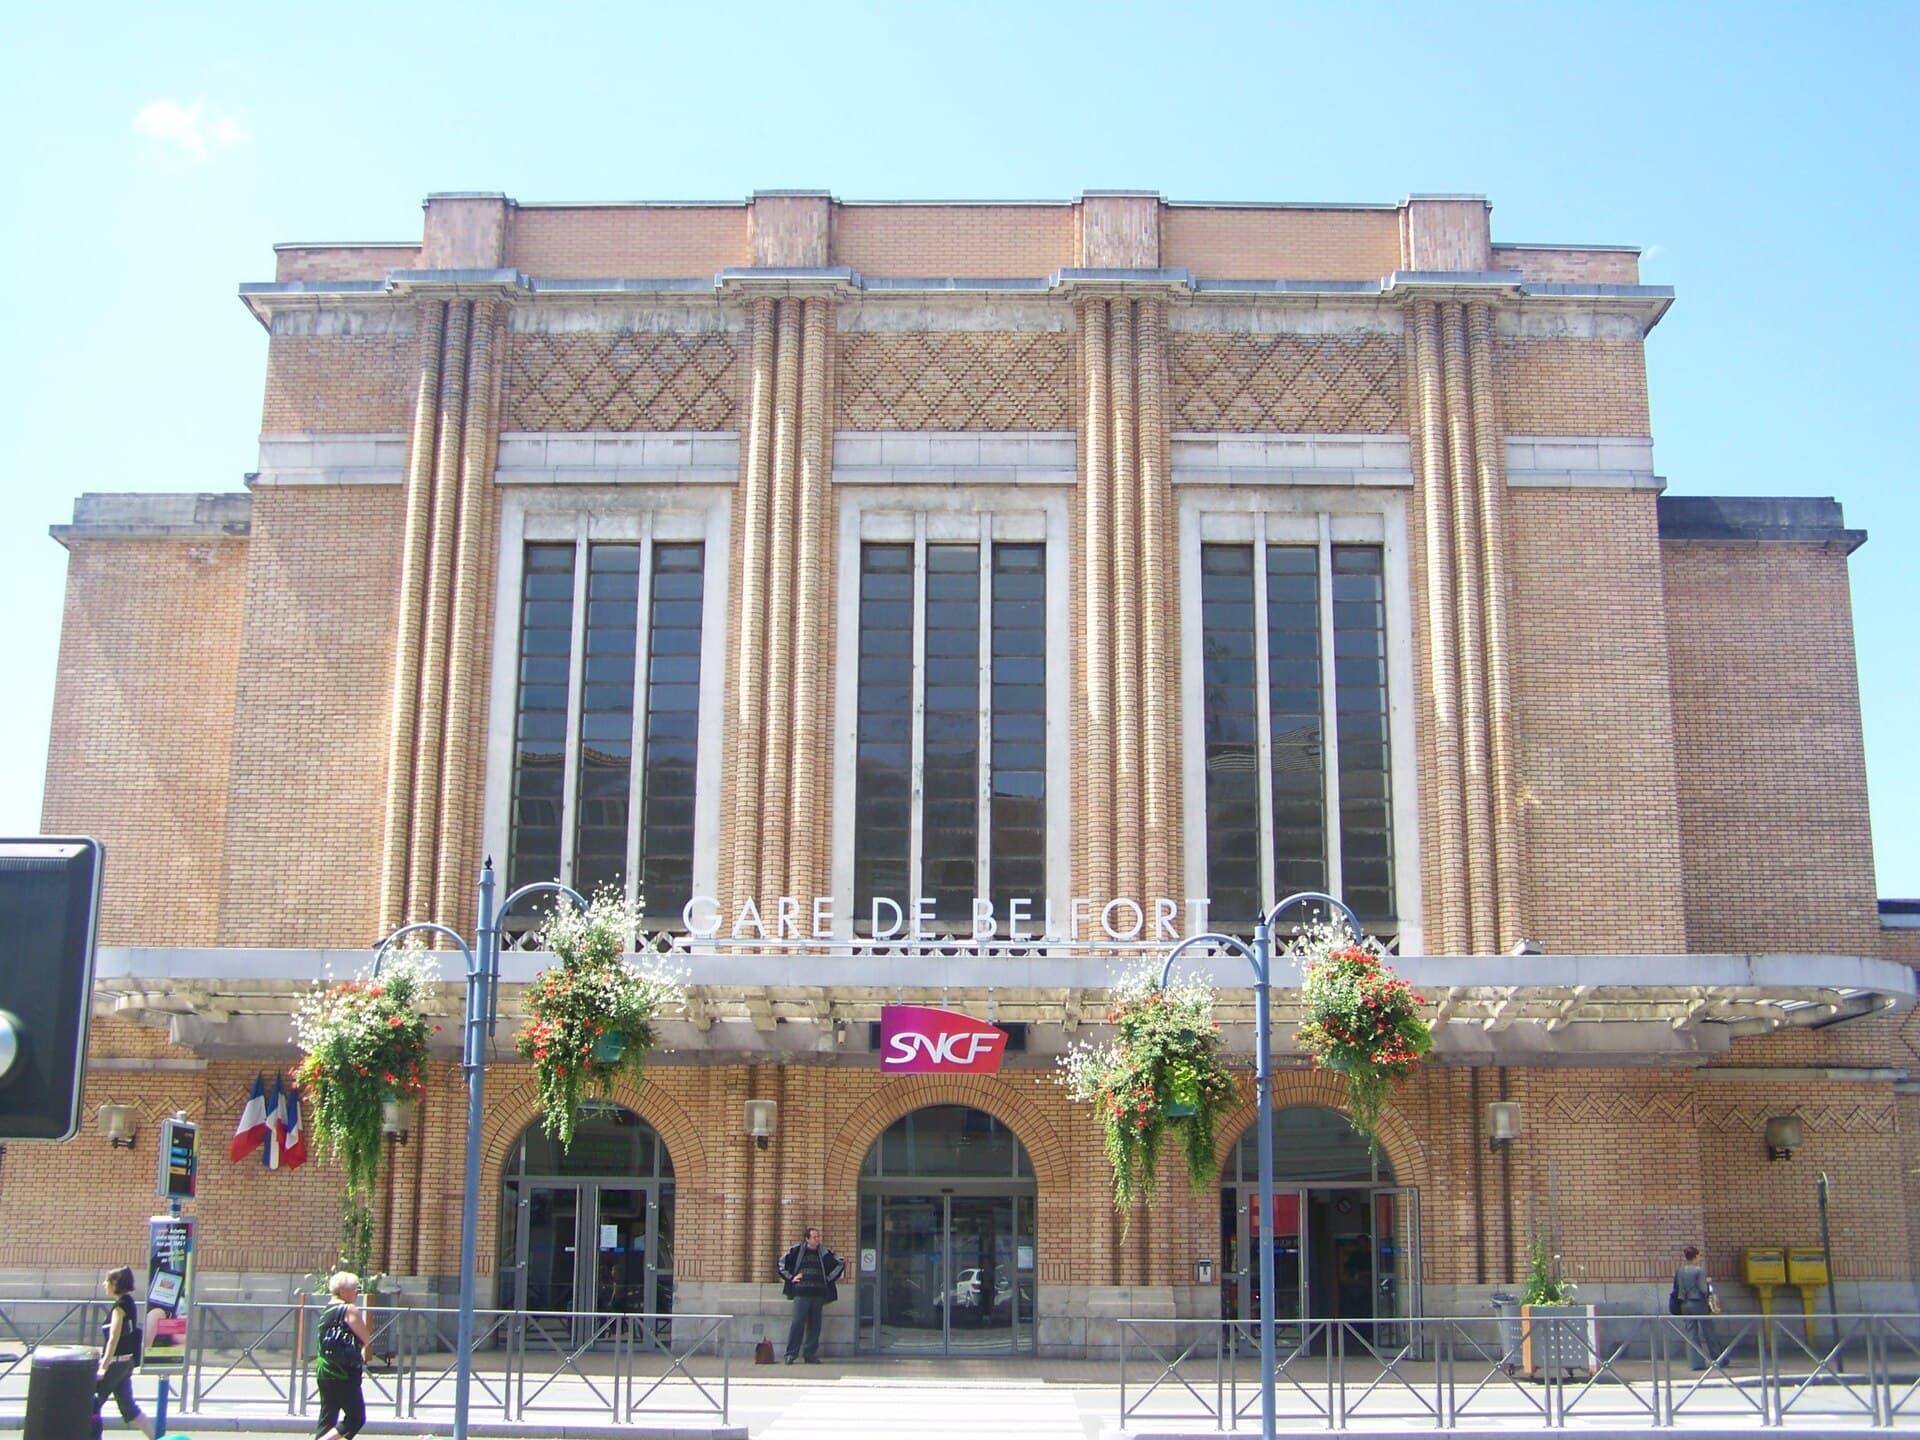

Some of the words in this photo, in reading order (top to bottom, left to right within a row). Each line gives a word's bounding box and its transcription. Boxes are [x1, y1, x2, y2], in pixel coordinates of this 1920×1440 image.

[682, 895, 834, 938] GARE
[872, 896, 937, 938] DE
[972, 897, 1211, 939] BELFORT
[885, 1032, 1000, 1064] SNCF
